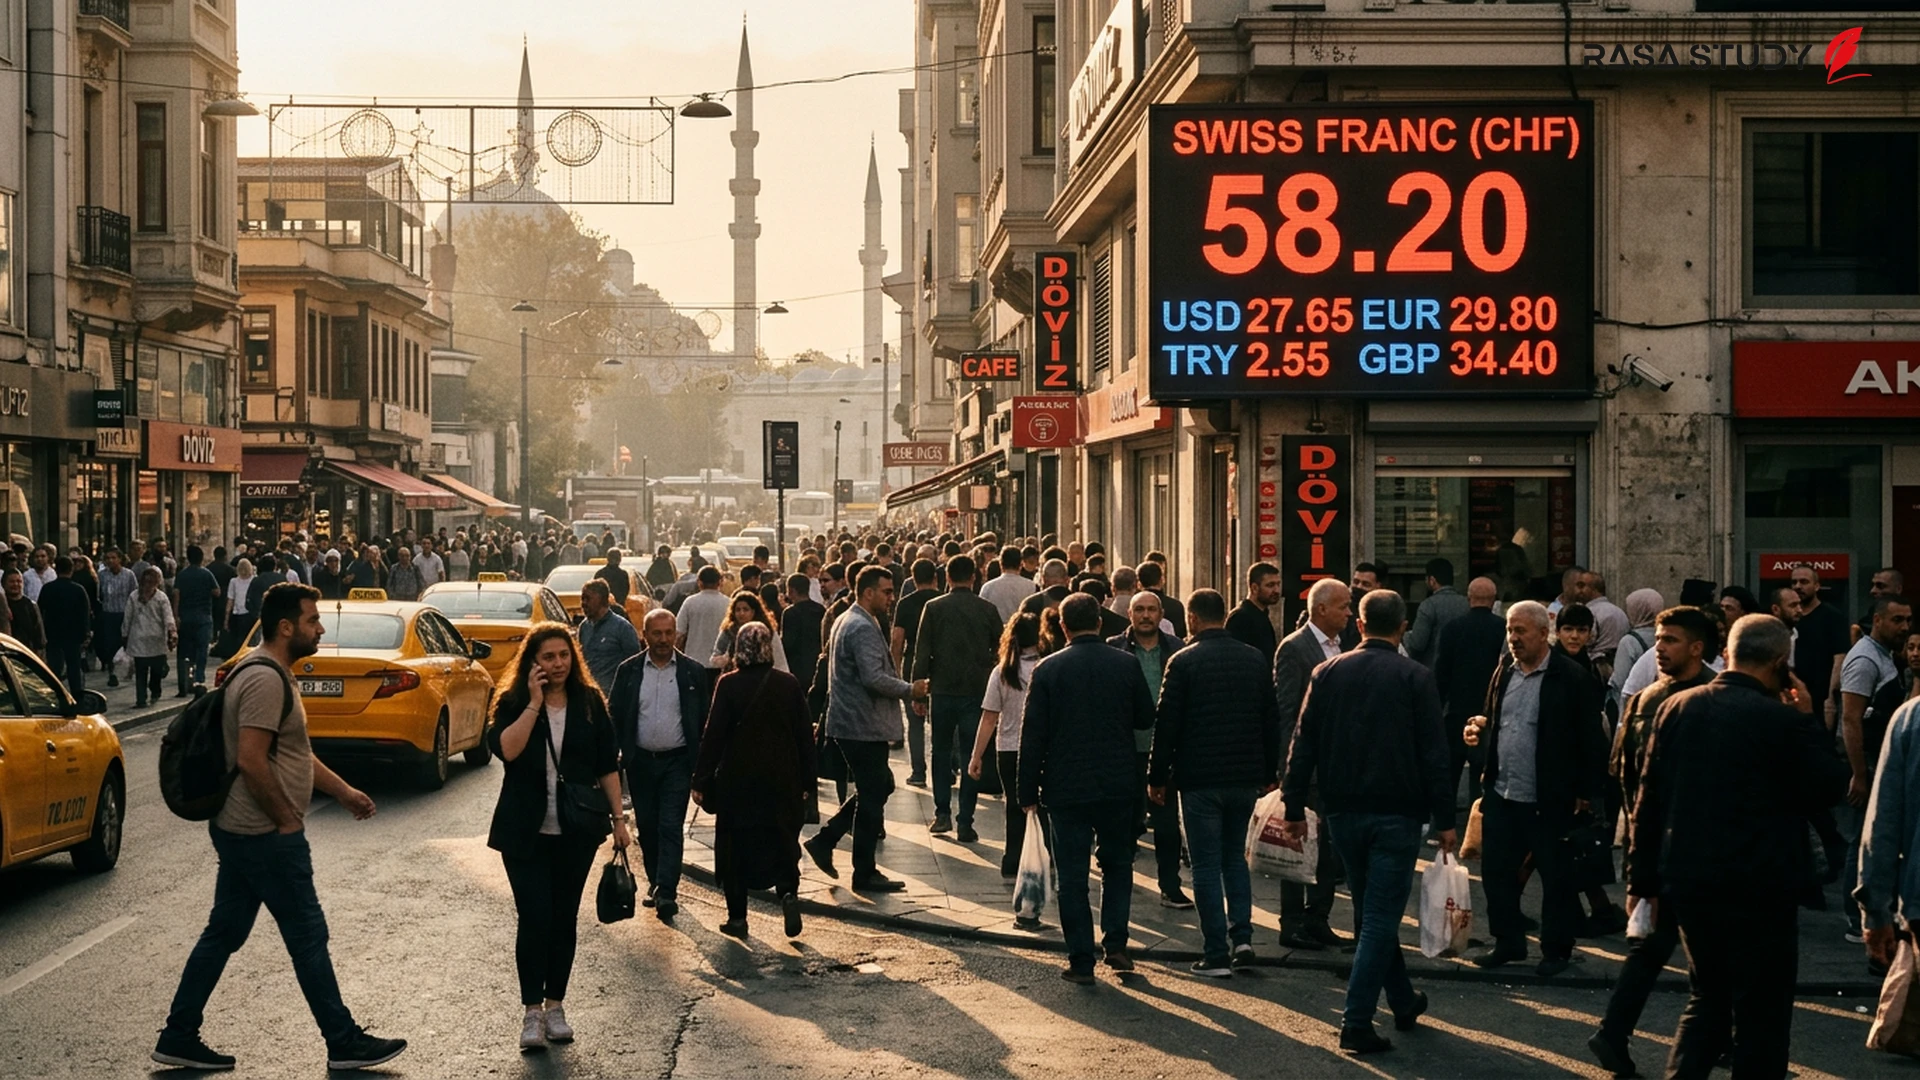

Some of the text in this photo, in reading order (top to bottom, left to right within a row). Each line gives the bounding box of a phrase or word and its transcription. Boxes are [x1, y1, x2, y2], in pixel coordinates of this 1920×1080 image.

[1173, 116, 1580, 160] SWISS FRANC (CHF)
[1202, 171, 1528, 275] 58.20
[1162, 295, 1558, 334] USD 27.65 EUR 29.80
[963, 357, 1018, 377] CAFE
[1162, 340, 1558, 377] TRY 2.55 GBP 34.40
